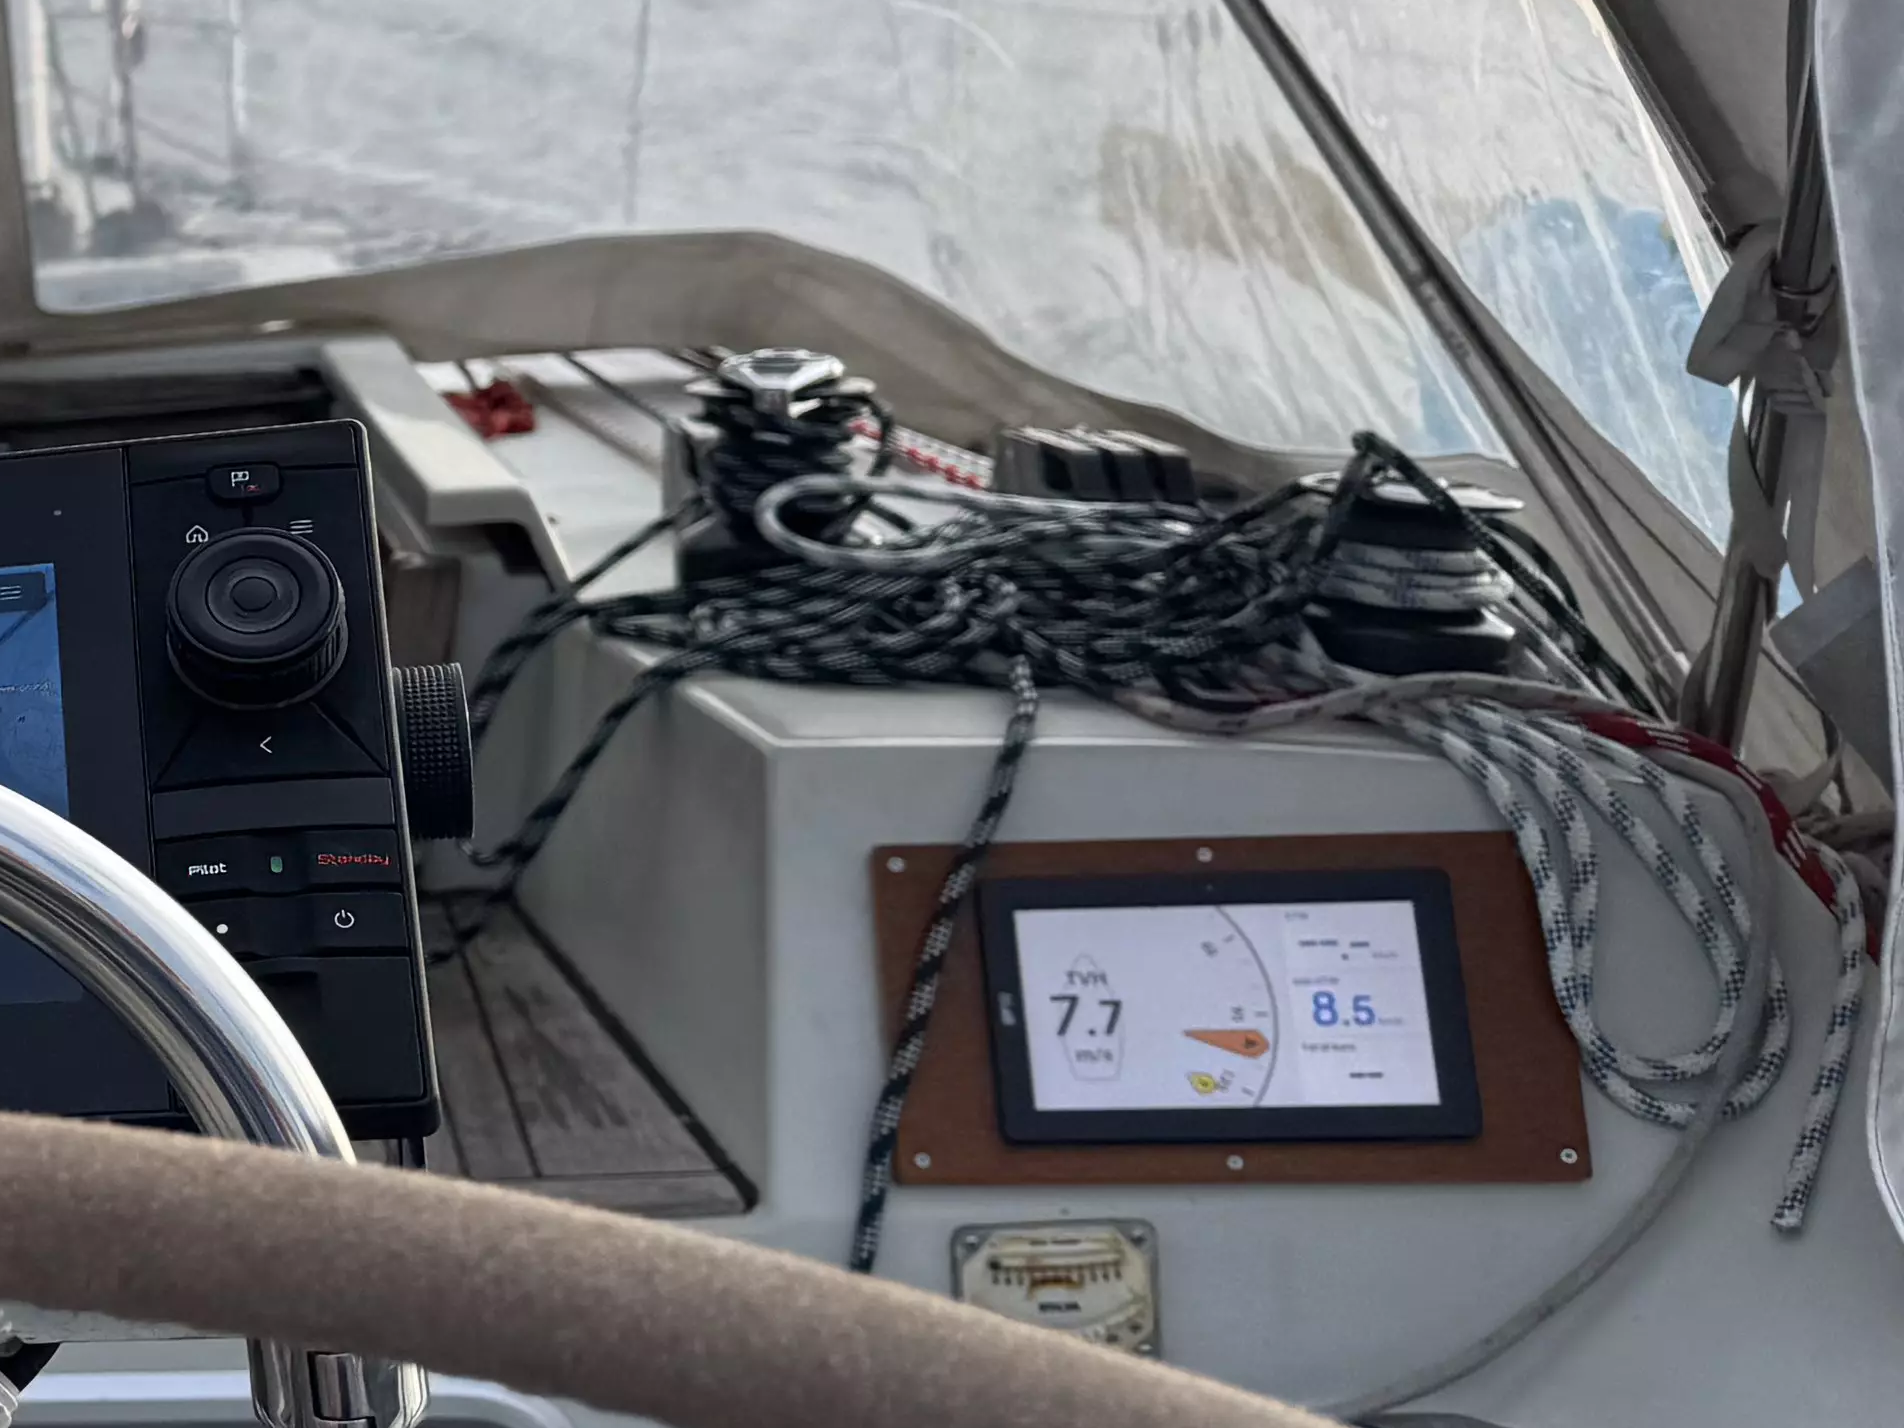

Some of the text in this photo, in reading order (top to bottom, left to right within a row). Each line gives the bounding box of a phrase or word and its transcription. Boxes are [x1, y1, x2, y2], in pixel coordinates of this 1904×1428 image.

[188, 862, 227, 875] Pilot
[1049, 994, 1122, 1037] 7.7
[1312, 991, 1375, 1027] 8.5
